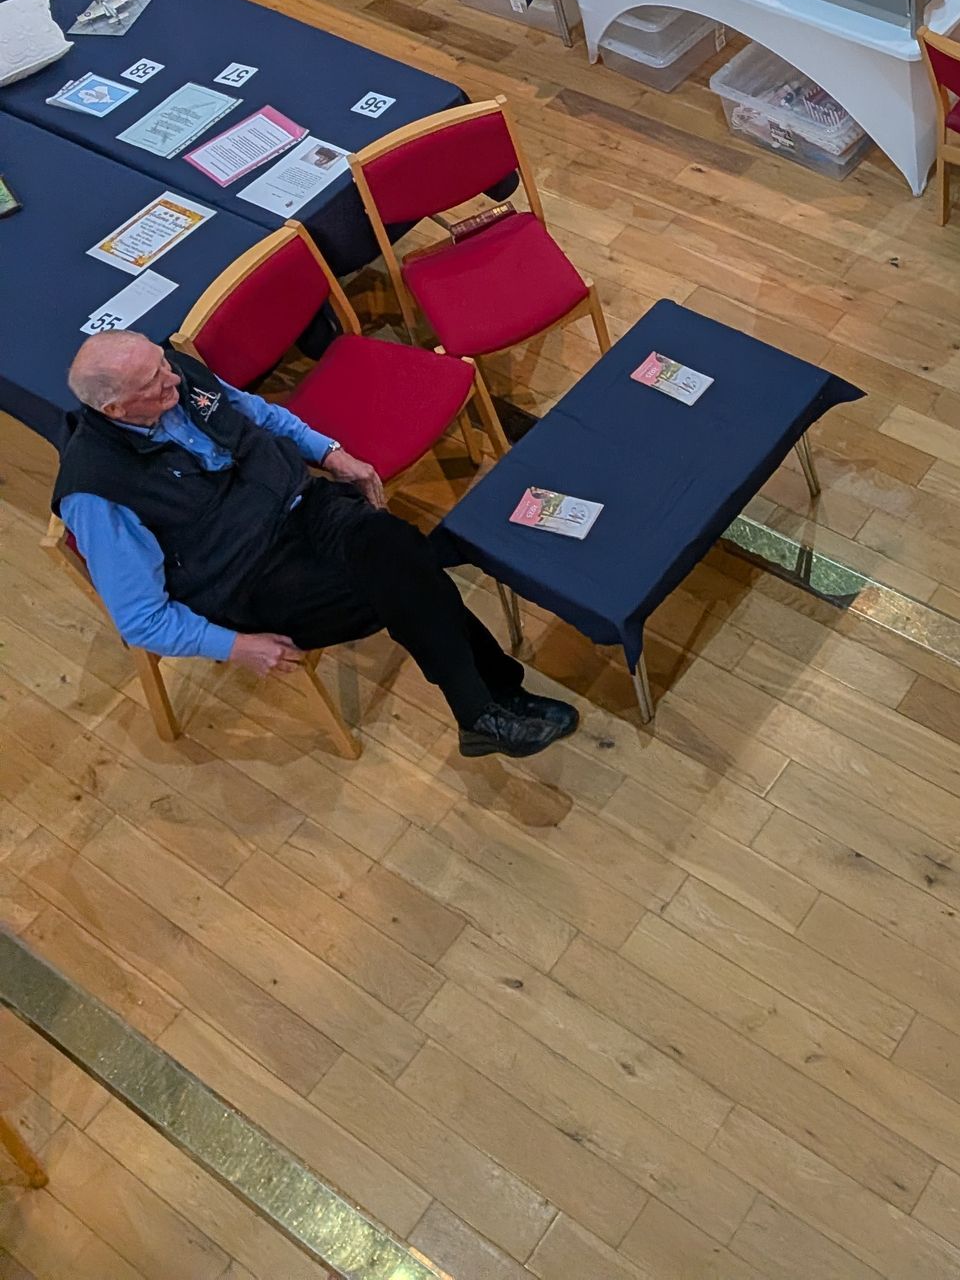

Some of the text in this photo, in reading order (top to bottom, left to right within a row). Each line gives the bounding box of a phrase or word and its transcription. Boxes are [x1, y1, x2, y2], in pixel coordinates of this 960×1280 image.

[130, 63, 156, 78] 58
[221, 68, 249, 83] 57
[360, 97, 386, 113] 56
[90, 313, 122, 331] 55
